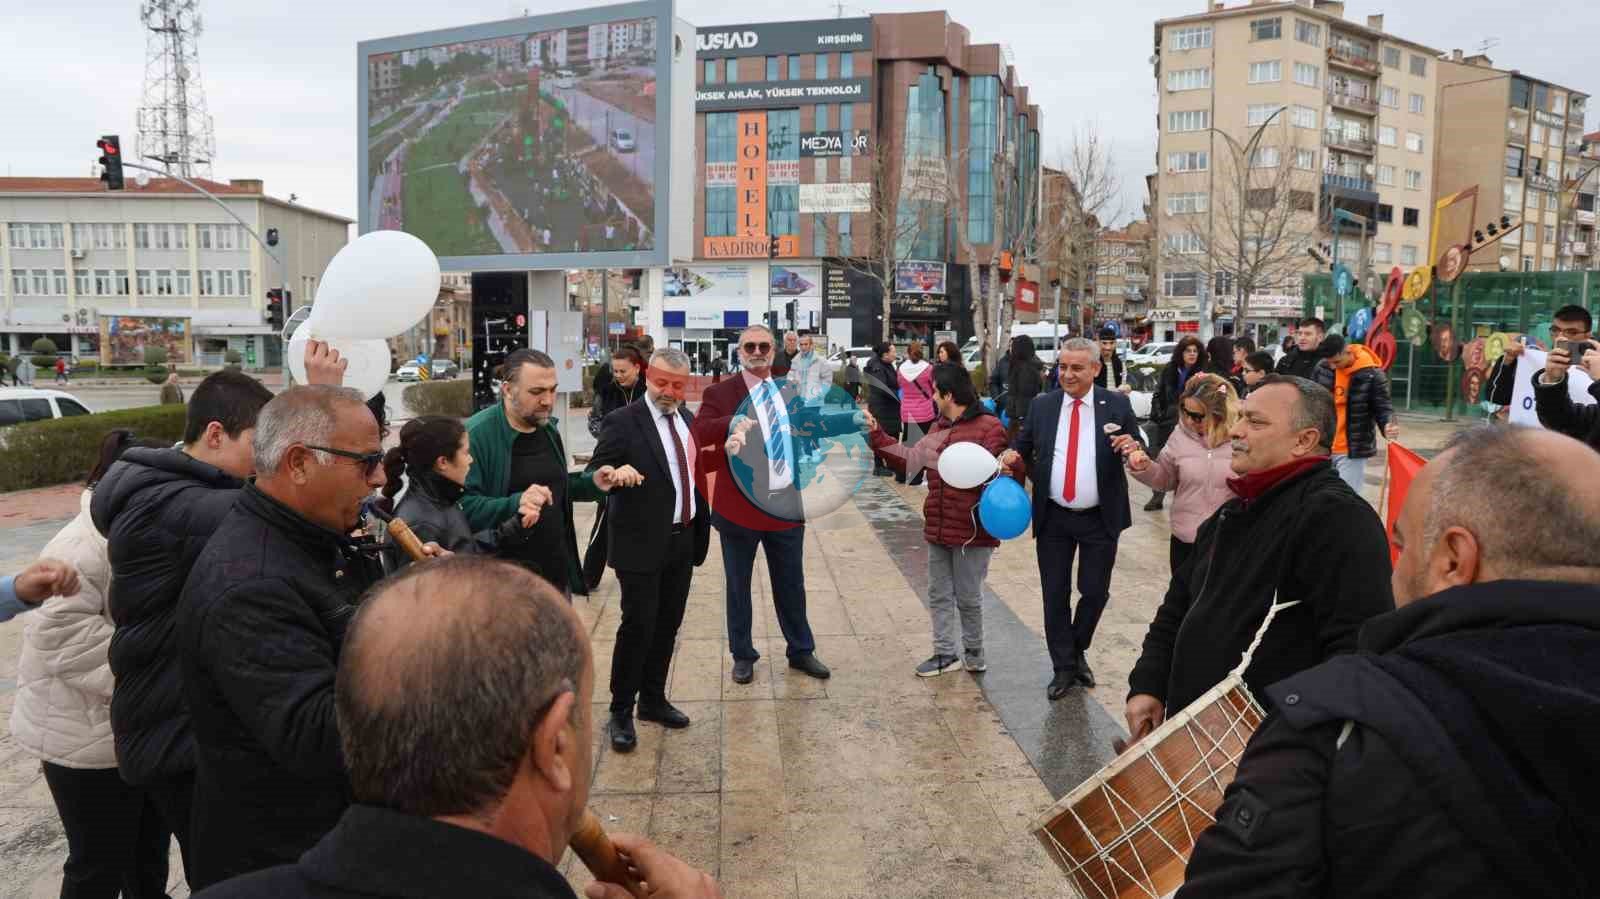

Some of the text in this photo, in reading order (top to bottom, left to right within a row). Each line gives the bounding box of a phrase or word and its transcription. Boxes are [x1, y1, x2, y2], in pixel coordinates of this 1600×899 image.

[696, 89, 726, 101] ÜKSEK
[766, 87, 805, 98] YÜKSEK
[806, 84, 861, 96] TEKNOLOJİ
[743, 122, 760, 227] HOTEL
